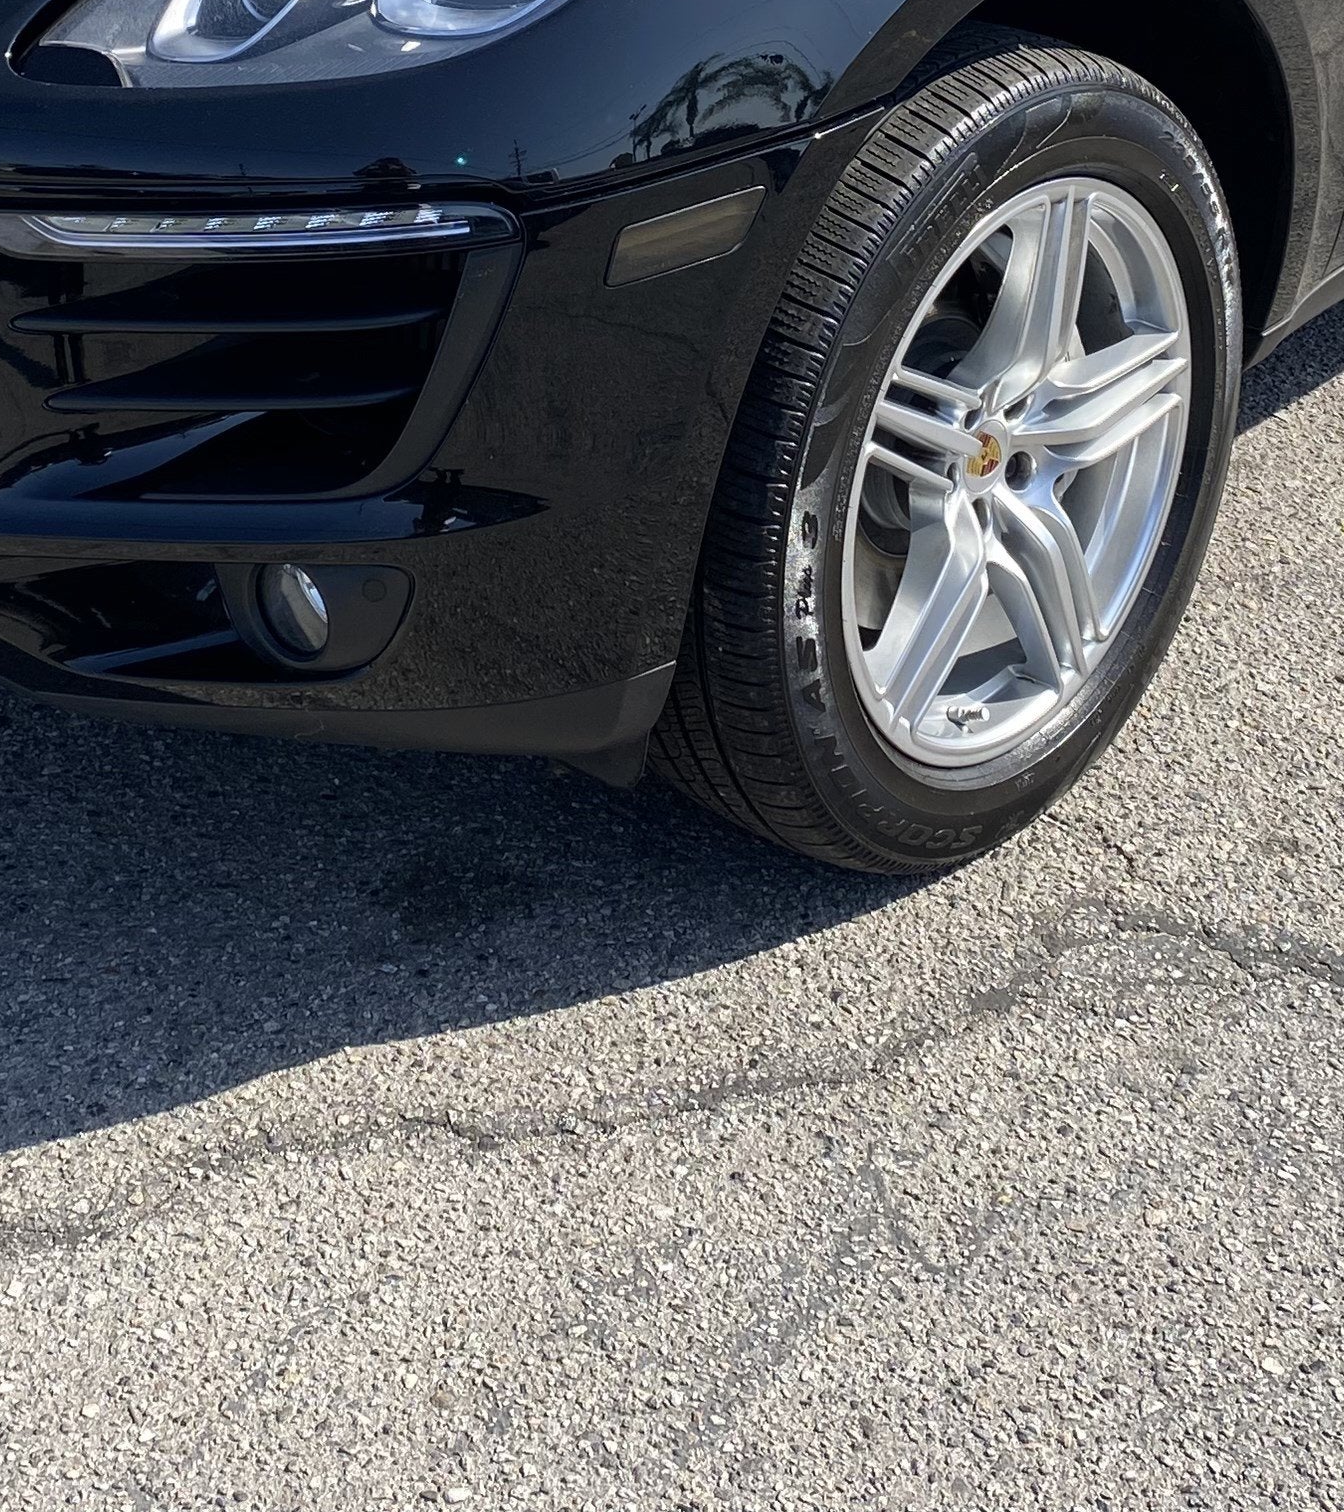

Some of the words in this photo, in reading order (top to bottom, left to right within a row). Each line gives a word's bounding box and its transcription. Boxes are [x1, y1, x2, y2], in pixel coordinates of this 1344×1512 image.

[801, 510, 819, 551] 3
[795, 563, 818, 621] Plus
[794, 635, 828, 716] AS
[810, 726, 984, 850] SCORPION
